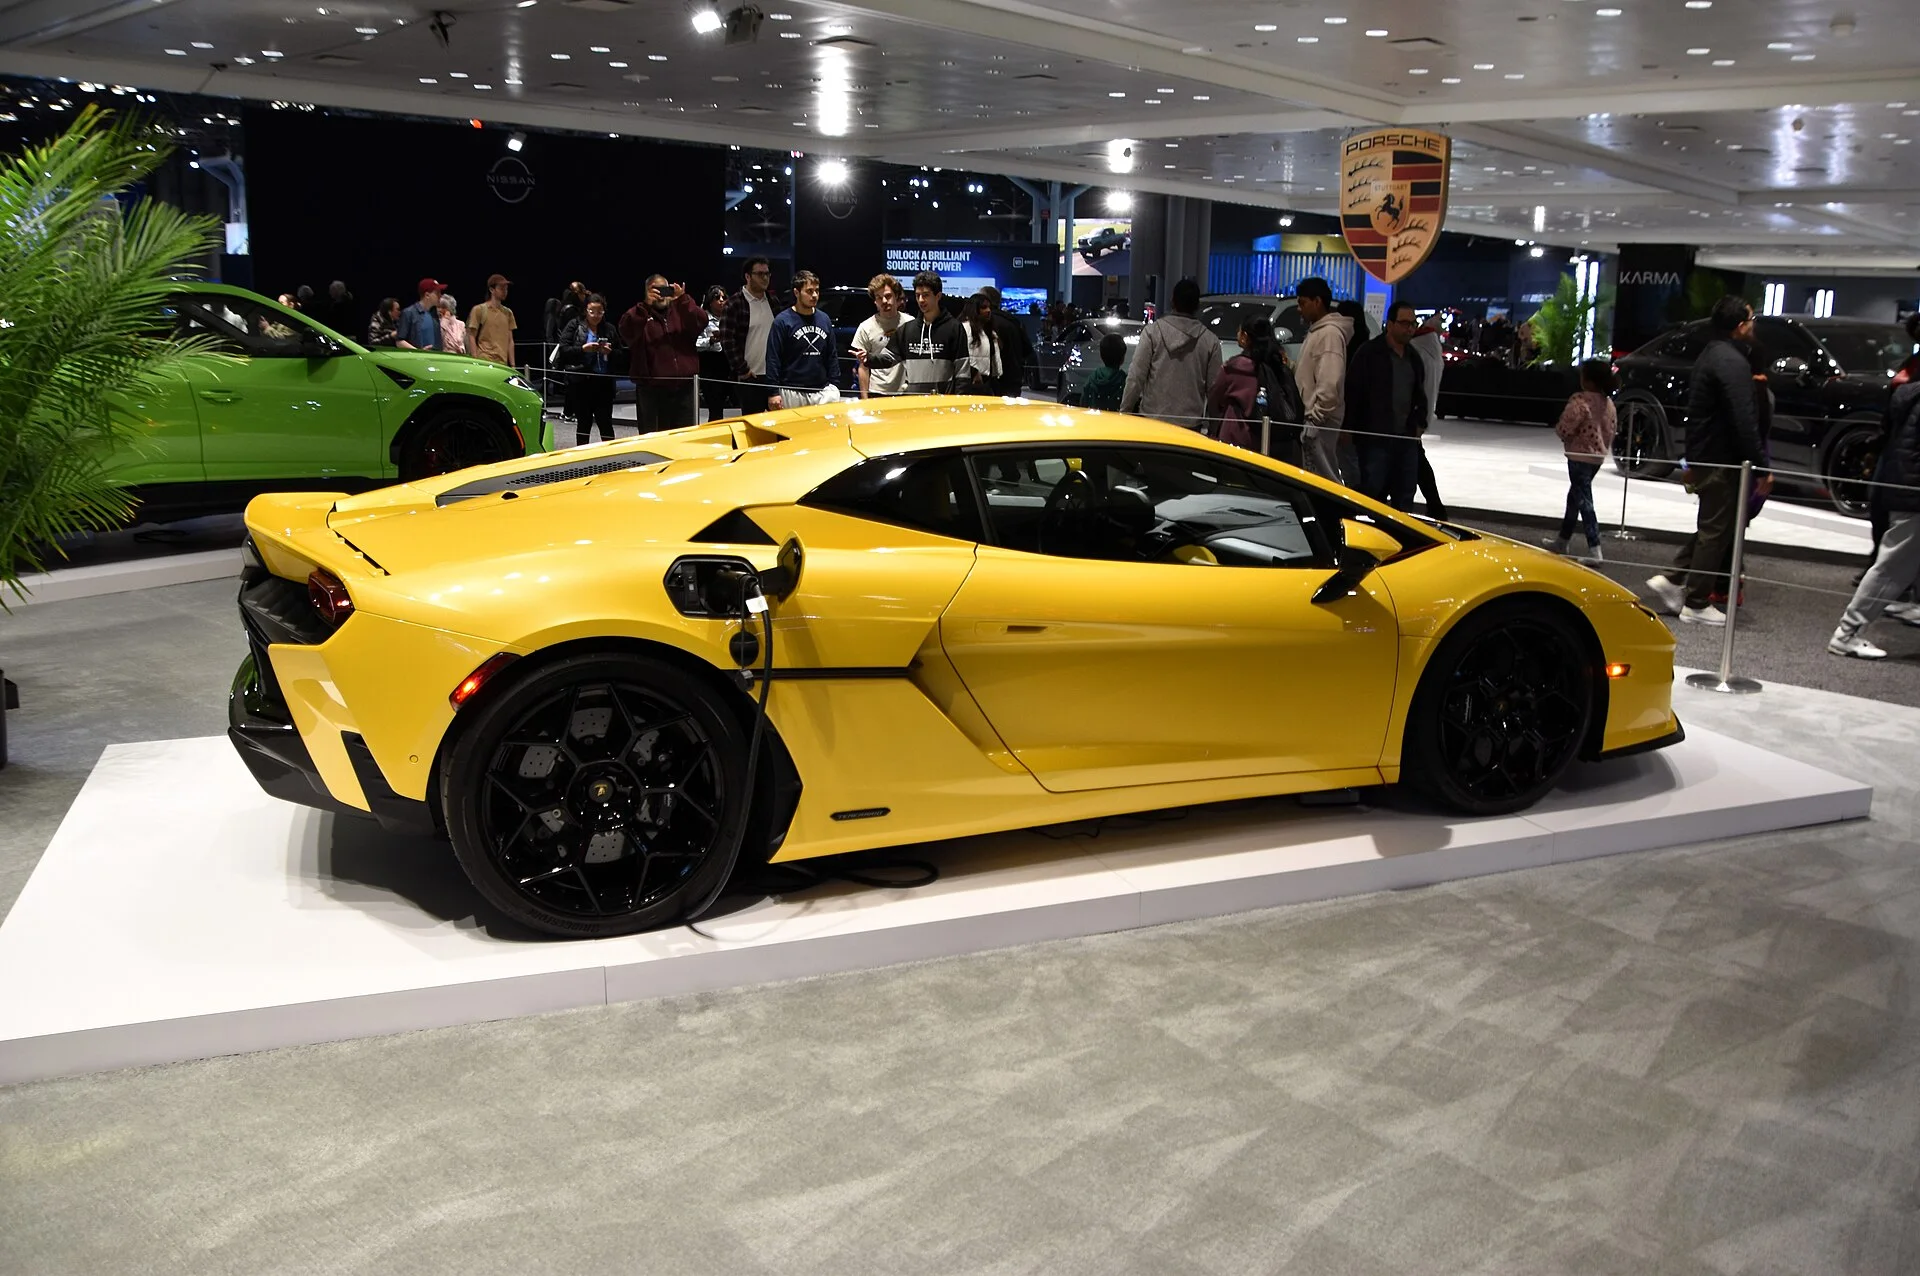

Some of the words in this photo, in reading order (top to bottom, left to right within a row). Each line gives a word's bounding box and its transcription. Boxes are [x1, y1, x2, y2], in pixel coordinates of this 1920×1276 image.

[1345, 134, 1441, 156] PORSCHE
[486, 174, 536, 185] NISSAN
[886, 250, 921, 261] UNLOCK
[921, 250, 928, 261] A
[928, 250, 971, 261] BRILLIANT
[886, 260, 920, 271] SOURCE
[920, 260, 931, 271] OF
[932, 261, 962, 272] POWER
[1619, 271, 1681, 285] KARMA
